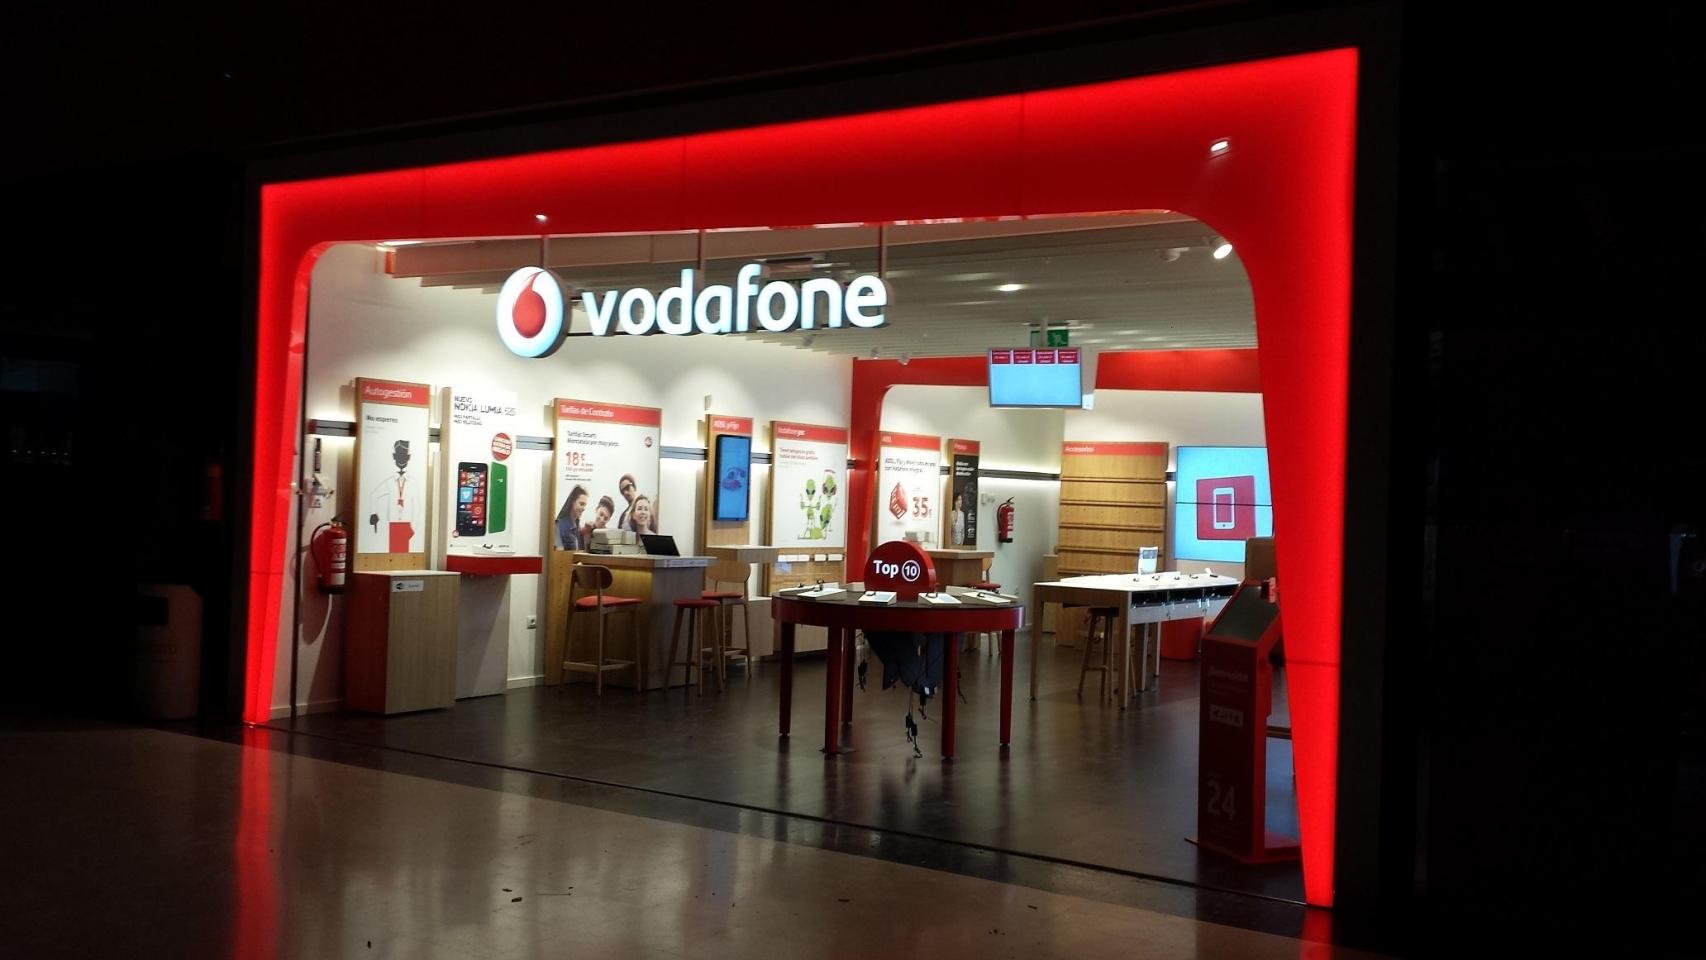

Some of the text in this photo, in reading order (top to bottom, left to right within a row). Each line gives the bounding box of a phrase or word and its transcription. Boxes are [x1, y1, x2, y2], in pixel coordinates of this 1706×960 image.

[582, 263, 888, 336] vodafone
[365, 386, 412, 399] Autogestión
[454, 402, 478, 412] NOKIA
[480, 405, 503, 415] LUMIA
[589, 407, 614, 418] Contrato
[873, 560, 918, 579] Top 10
[1207, 779, 1236, 821] 24
